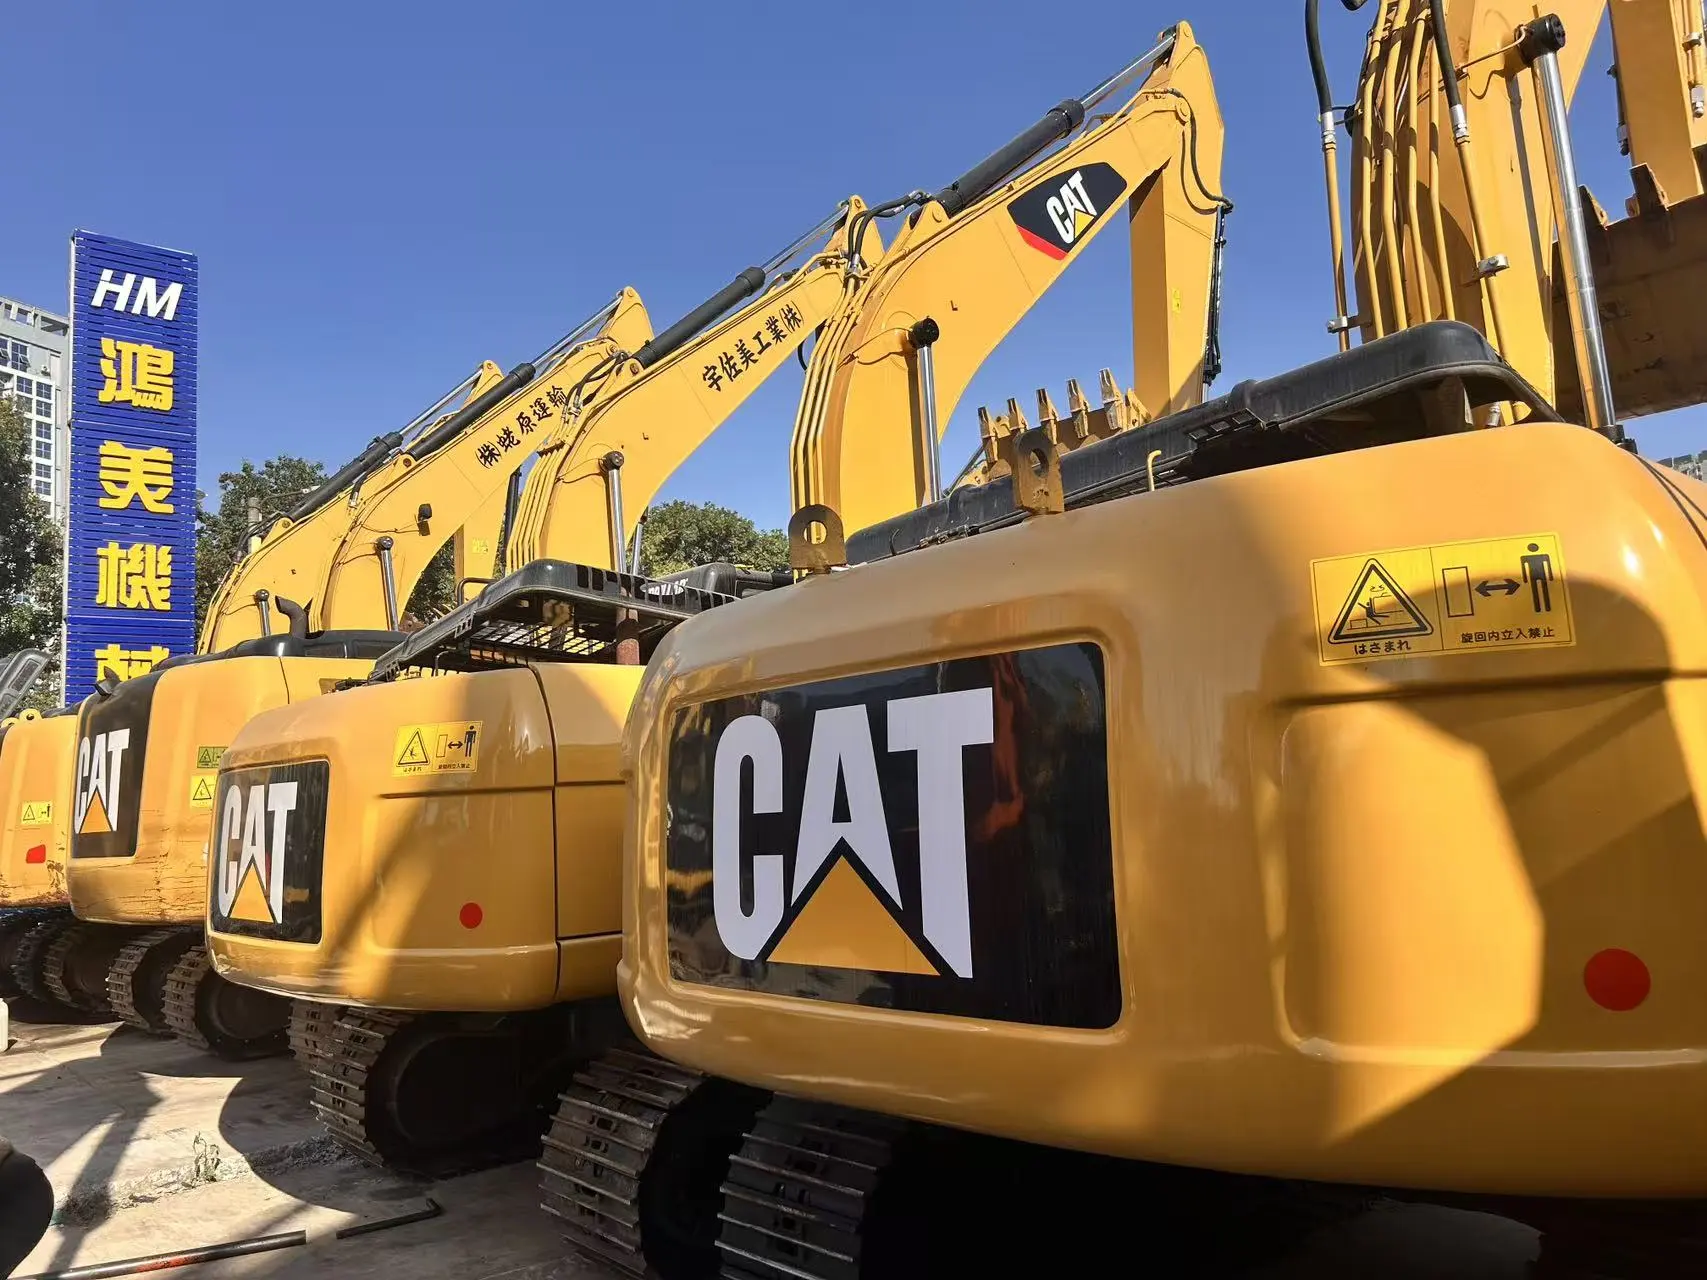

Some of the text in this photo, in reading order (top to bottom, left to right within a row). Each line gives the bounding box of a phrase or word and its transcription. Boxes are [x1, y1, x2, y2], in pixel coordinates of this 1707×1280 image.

[1046, 170, 1098, 244] CAT
[90, 268, 183, 321] HM
[702, 299, 804, 392] 宇佐美工業(株)
[1353, 638, 1412, 656] はさまれ
[1460, 626, 1556, 644] 旋回内立入禁止
[74, 728, 131, 834] CAT
[218, 781, 298, 924] CAT
[713, 687, 994, 979] CAT
